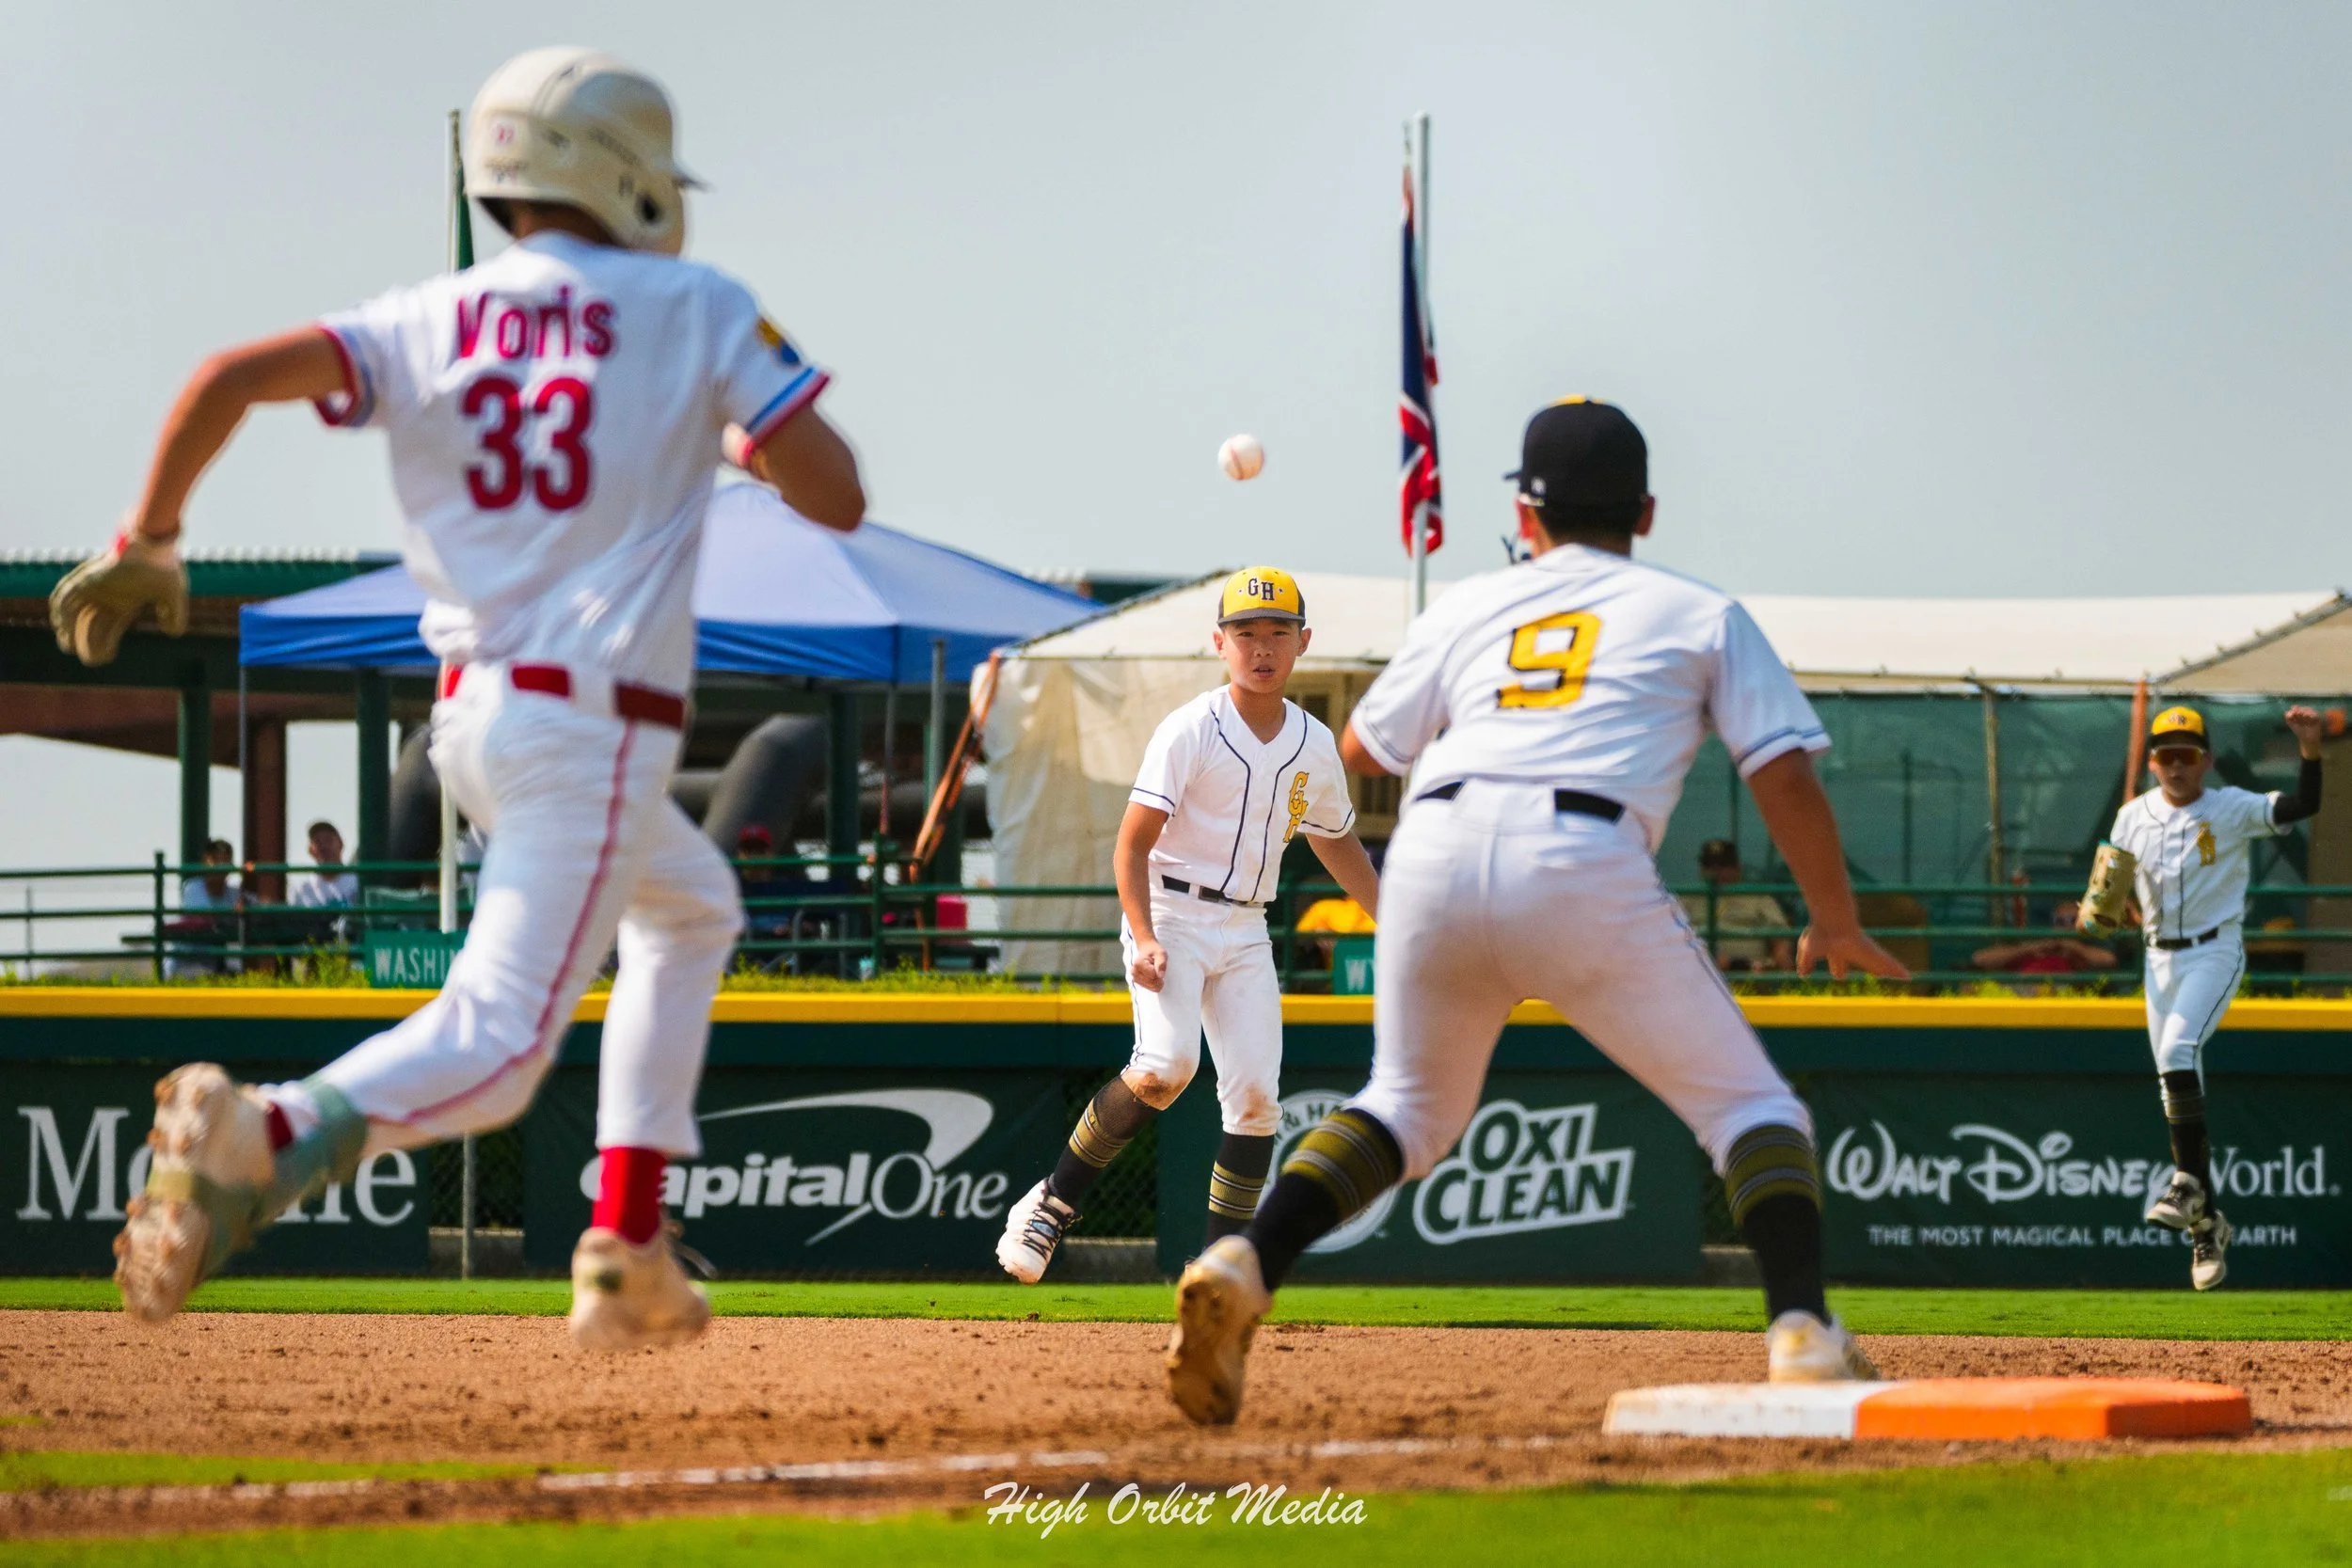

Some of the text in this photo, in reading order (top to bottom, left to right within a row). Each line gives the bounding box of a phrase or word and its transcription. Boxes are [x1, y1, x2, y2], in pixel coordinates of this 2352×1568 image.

[457, 287, 616, 359] Voris
[461, 372, 594, 512] 33
[1248, 578, 1275, 601] GH
[1495, 610, 1603, 708] 9
[1467, 1109, 1584, 1175] OXI
[1421, 1158, 1621, 1234] CLEAN
[1869, 1226, 1912, 1245] THE
[1920, 1226, 1982, 1245] MOST
[1994, 1226, 2093, 1245] MAGICAL
[2104, 1226, 2173, 1246] PLACE
